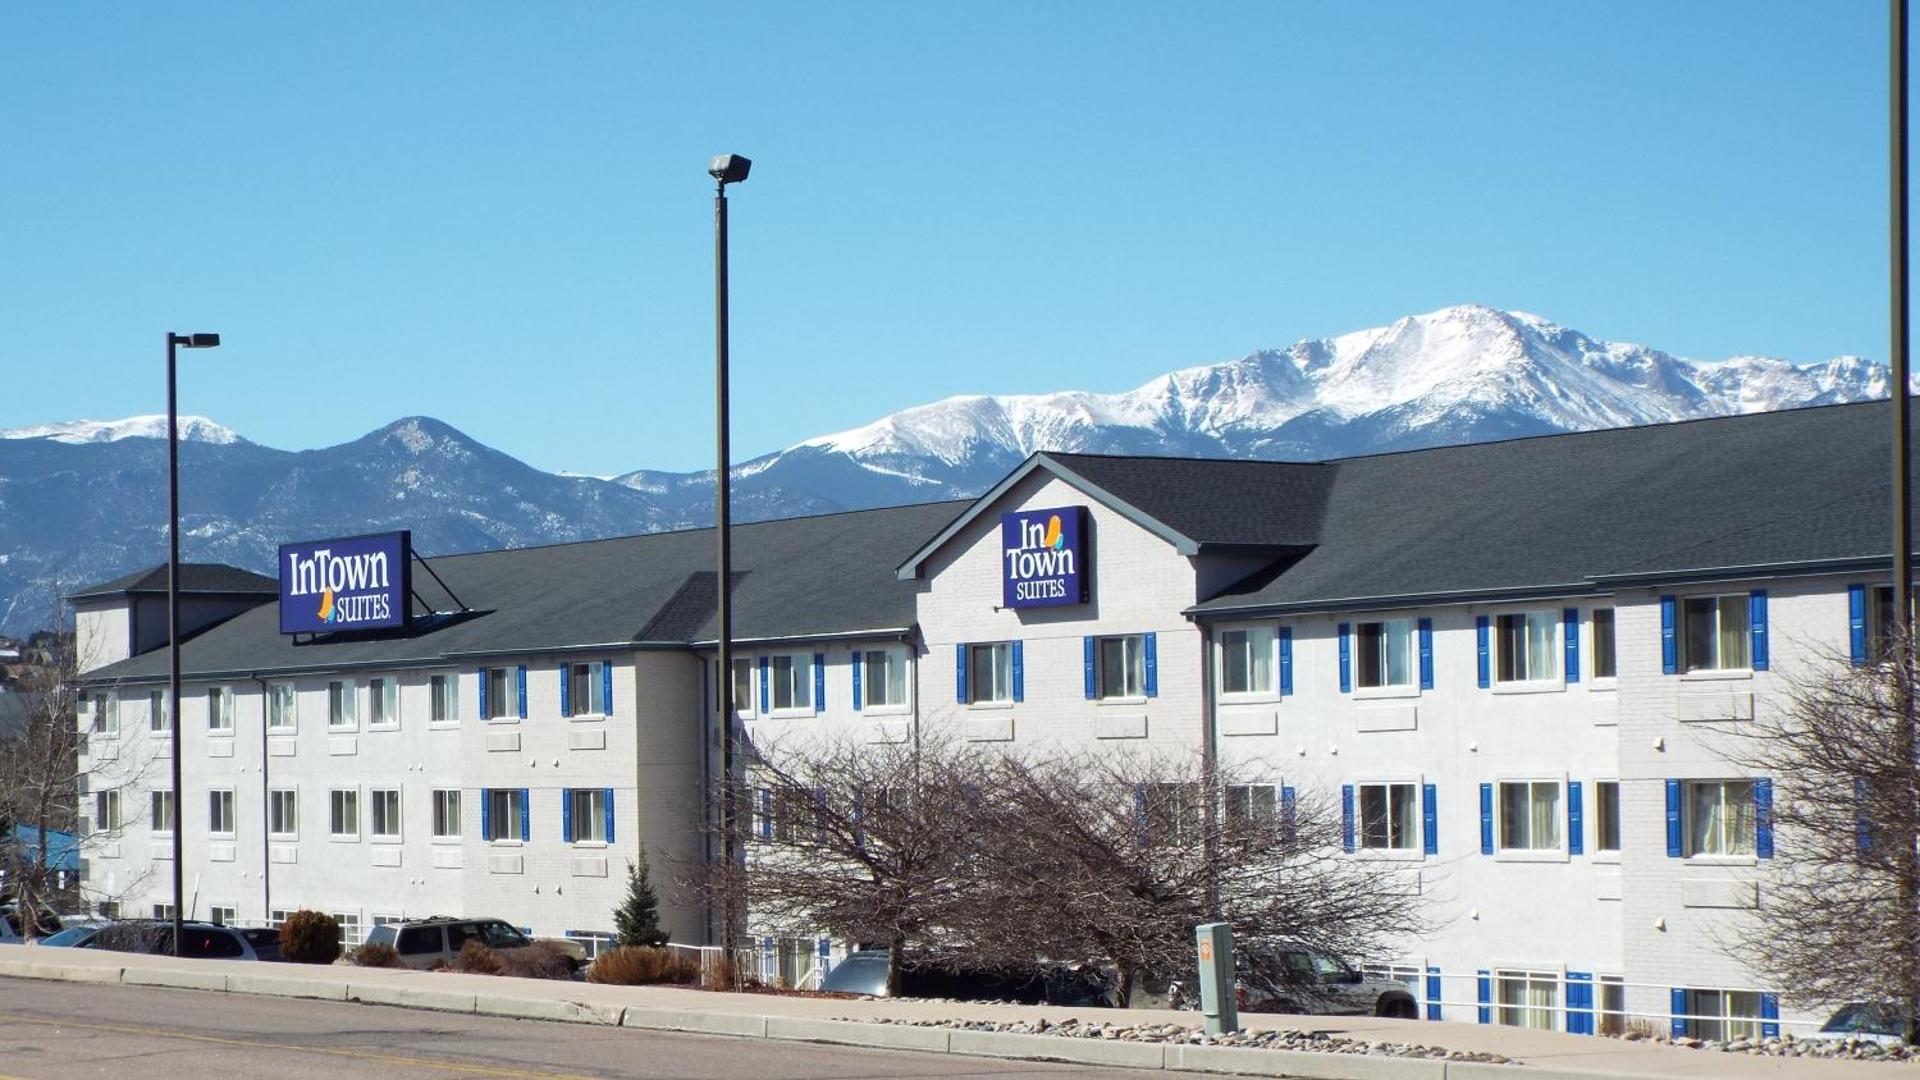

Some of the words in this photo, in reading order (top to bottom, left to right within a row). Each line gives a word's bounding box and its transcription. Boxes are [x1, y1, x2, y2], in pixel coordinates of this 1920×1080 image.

[1020, 518, 1046, 550] In
[289, 549, 390, 596] InTown
[1006, 548, 1076, 579] Town
[1016, 578, 1066, 601] SUITES
[336, 593, 390, 623] SUITES
